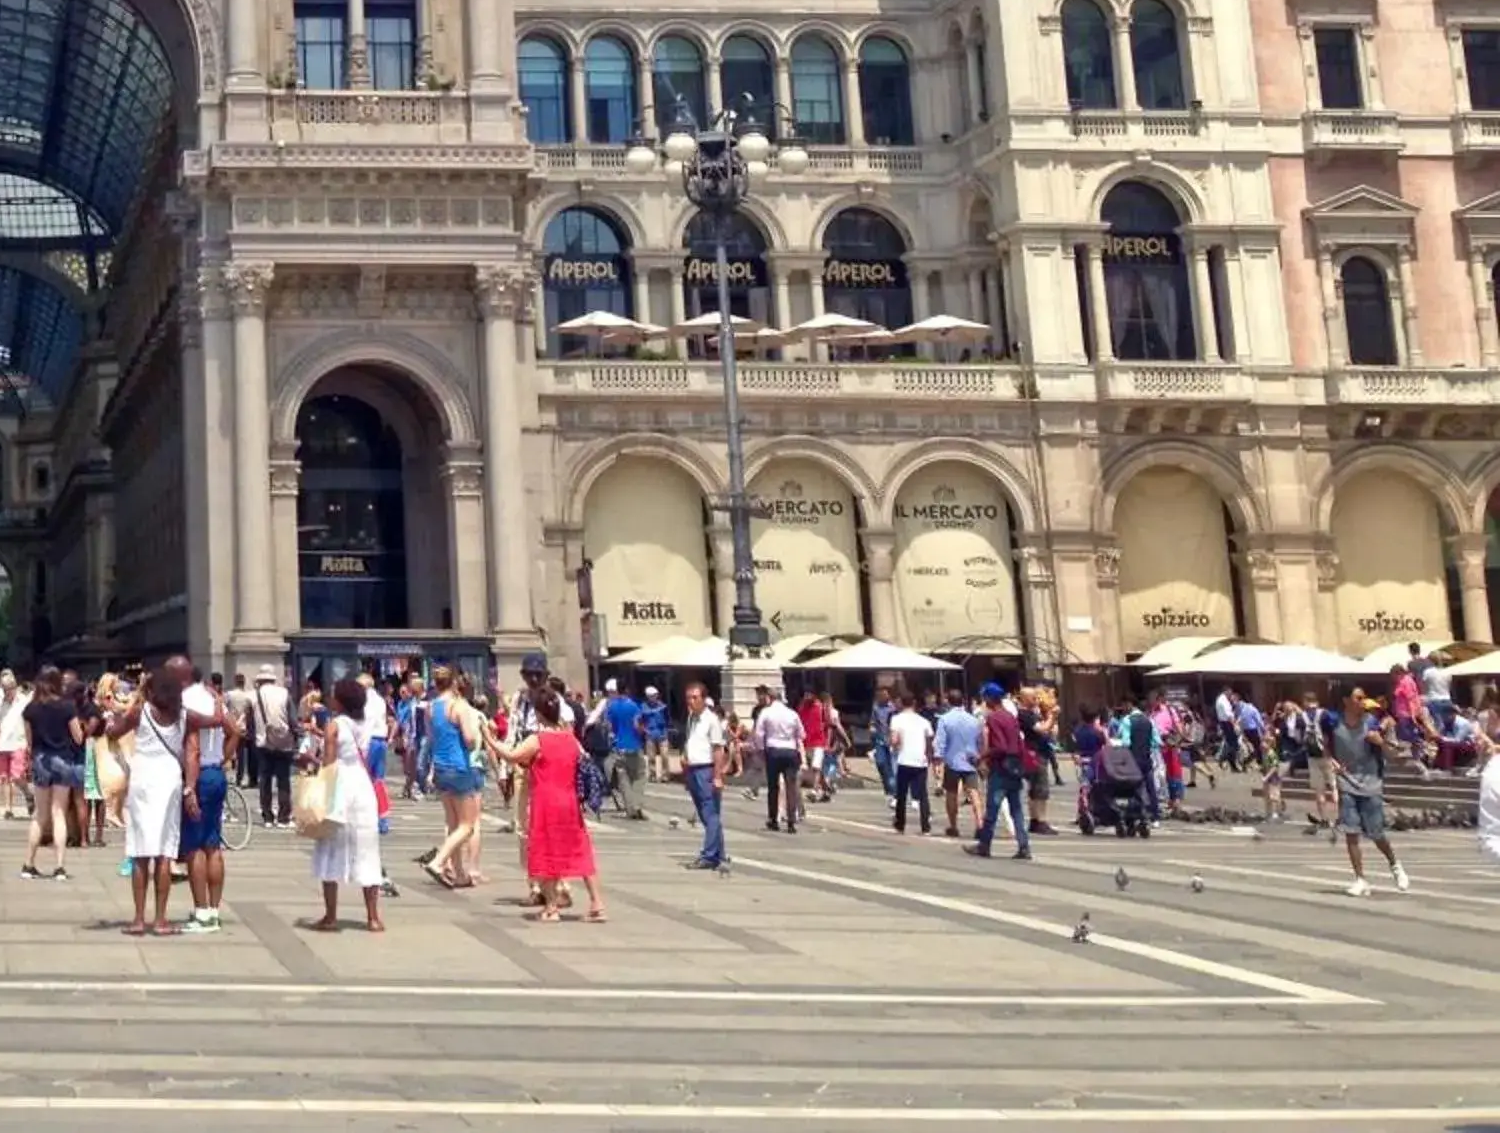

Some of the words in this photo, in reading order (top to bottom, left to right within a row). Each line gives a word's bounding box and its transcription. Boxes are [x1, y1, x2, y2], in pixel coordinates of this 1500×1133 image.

[550, 258, 617, 279] APEROL
[826, 260, 895, 282] APEROL
[913, 504, 998, 520] MERCATO
[623, 602, 676, 620] Motta
[1142, 607, 1210, 629] spizzico
[1358, 611, 1425, 635] spizzico
